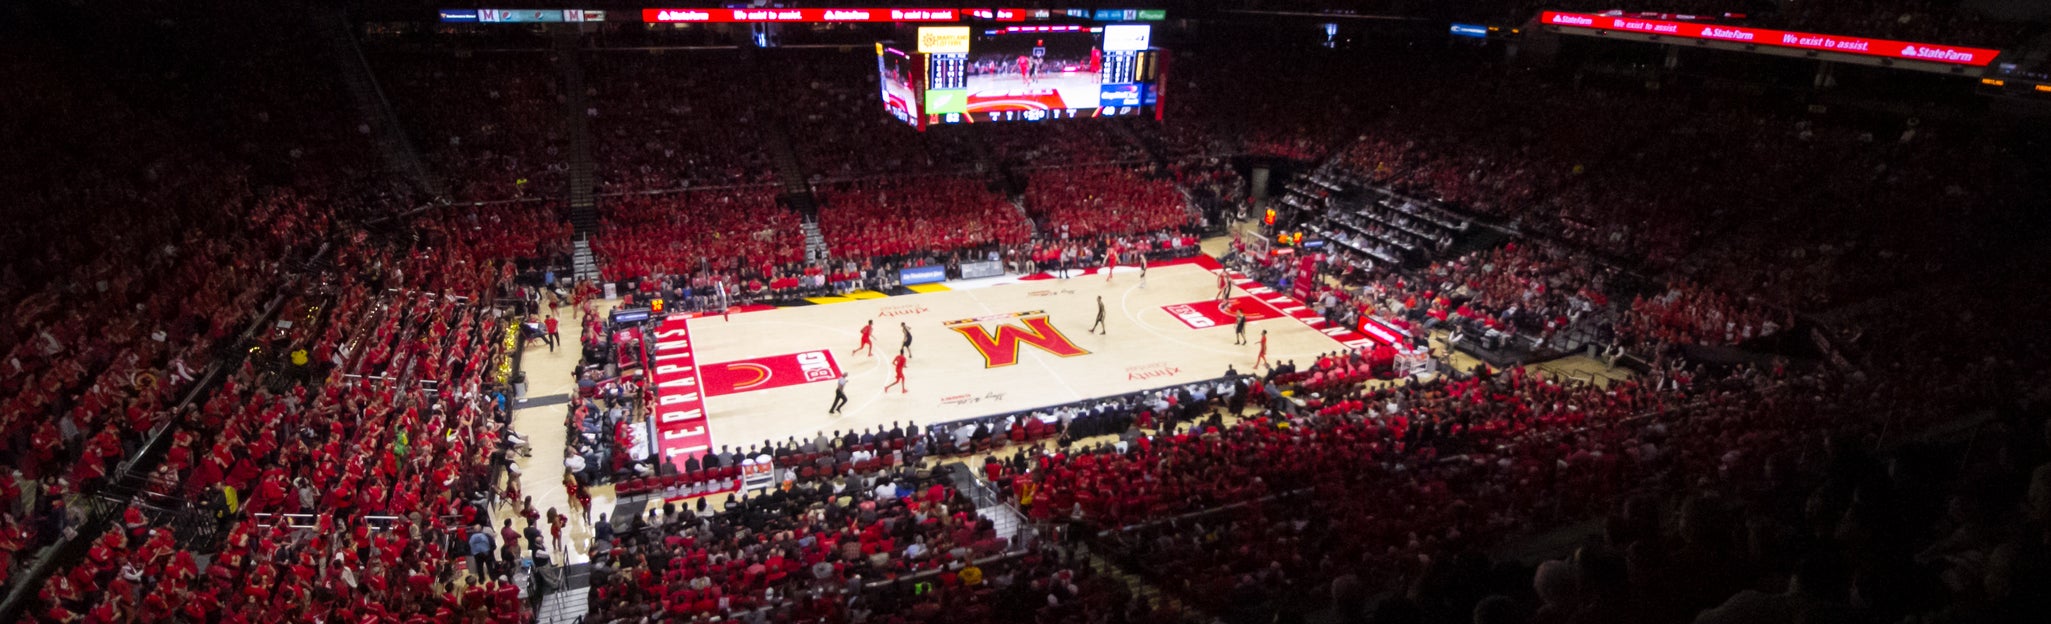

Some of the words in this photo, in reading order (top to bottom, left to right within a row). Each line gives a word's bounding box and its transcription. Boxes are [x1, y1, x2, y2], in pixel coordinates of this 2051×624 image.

[1614, 19, 1625, 28] We
[1626, 20, 1643, 29] exist
[1645, 22, 1653, 30] to
[1783, 33, 1797, 44] We
[1799, 35, 1822, 47] exist
[1824, 37, 1835, 48] to
[1836, 39, 1868, 51] assist.
[948, 315, 1093, 369] M
[654, 328, 708, 458] TERRAPINS
